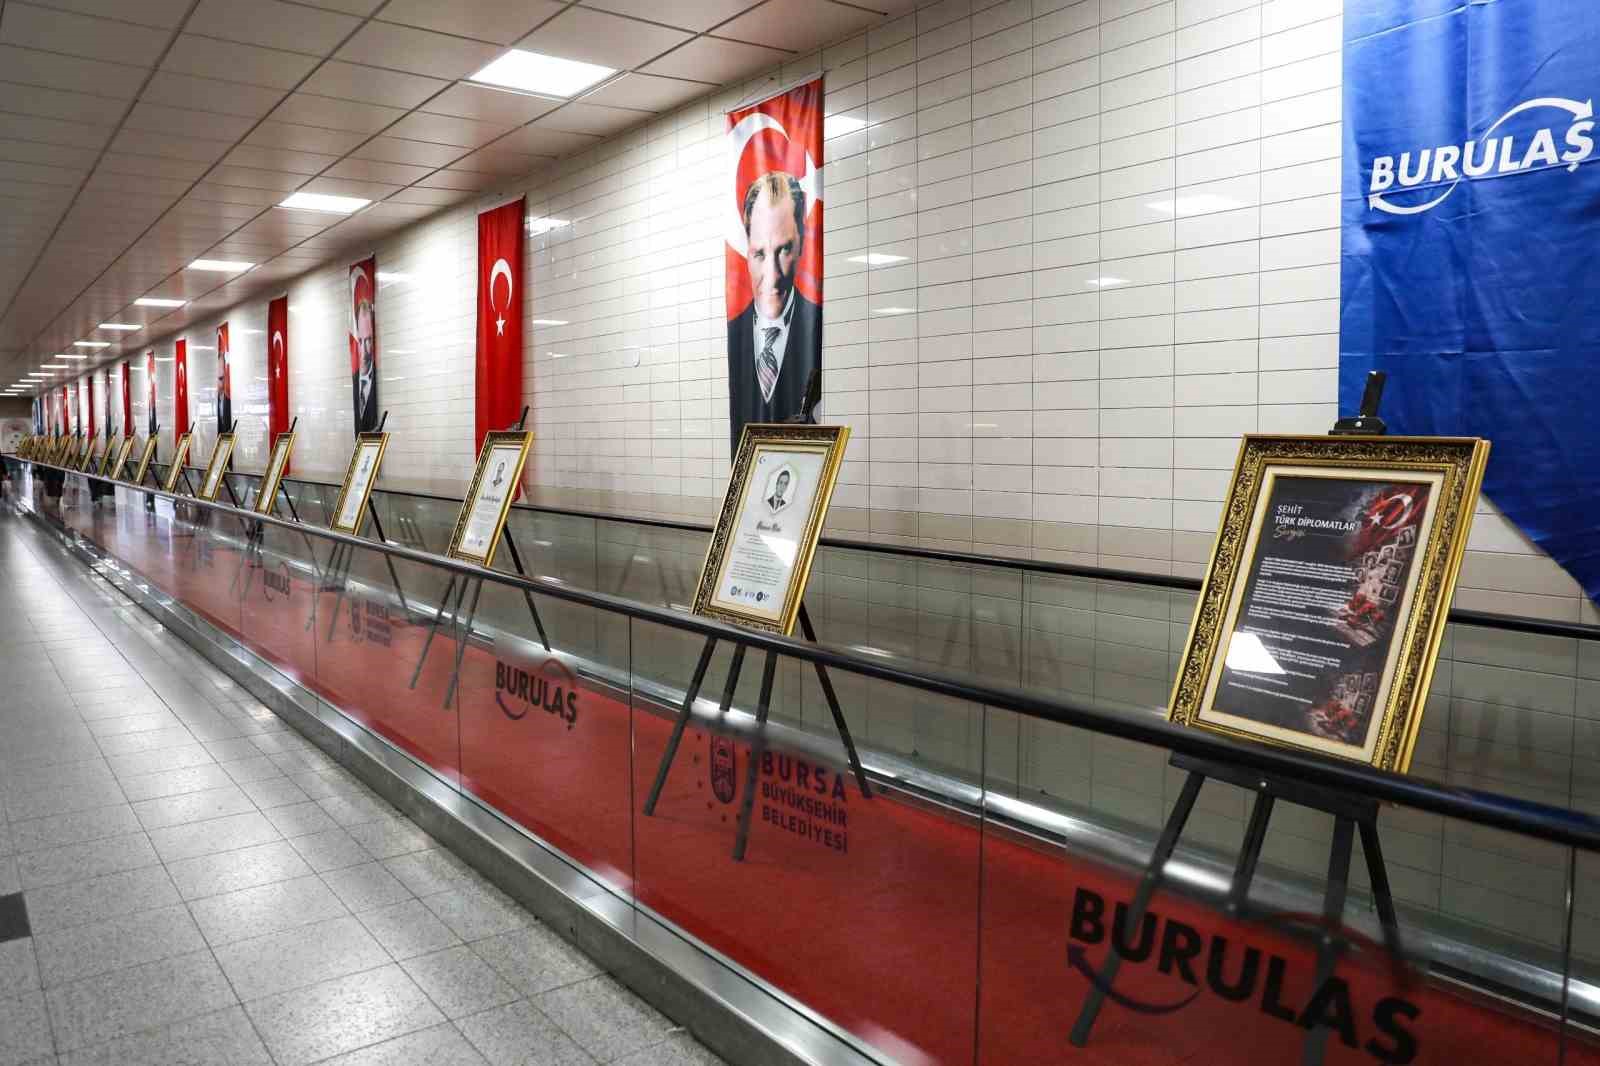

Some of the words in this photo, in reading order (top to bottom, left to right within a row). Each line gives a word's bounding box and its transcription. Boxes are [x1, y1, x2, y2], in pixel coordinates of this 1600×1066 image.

[1369, 121, 1596, 192] BURULAŞ
[1274, 515, 1297, 526] TÜRK
[496, 660, 577, 731] BURULAŞ
[762, 750, 847, 802] BURSA
